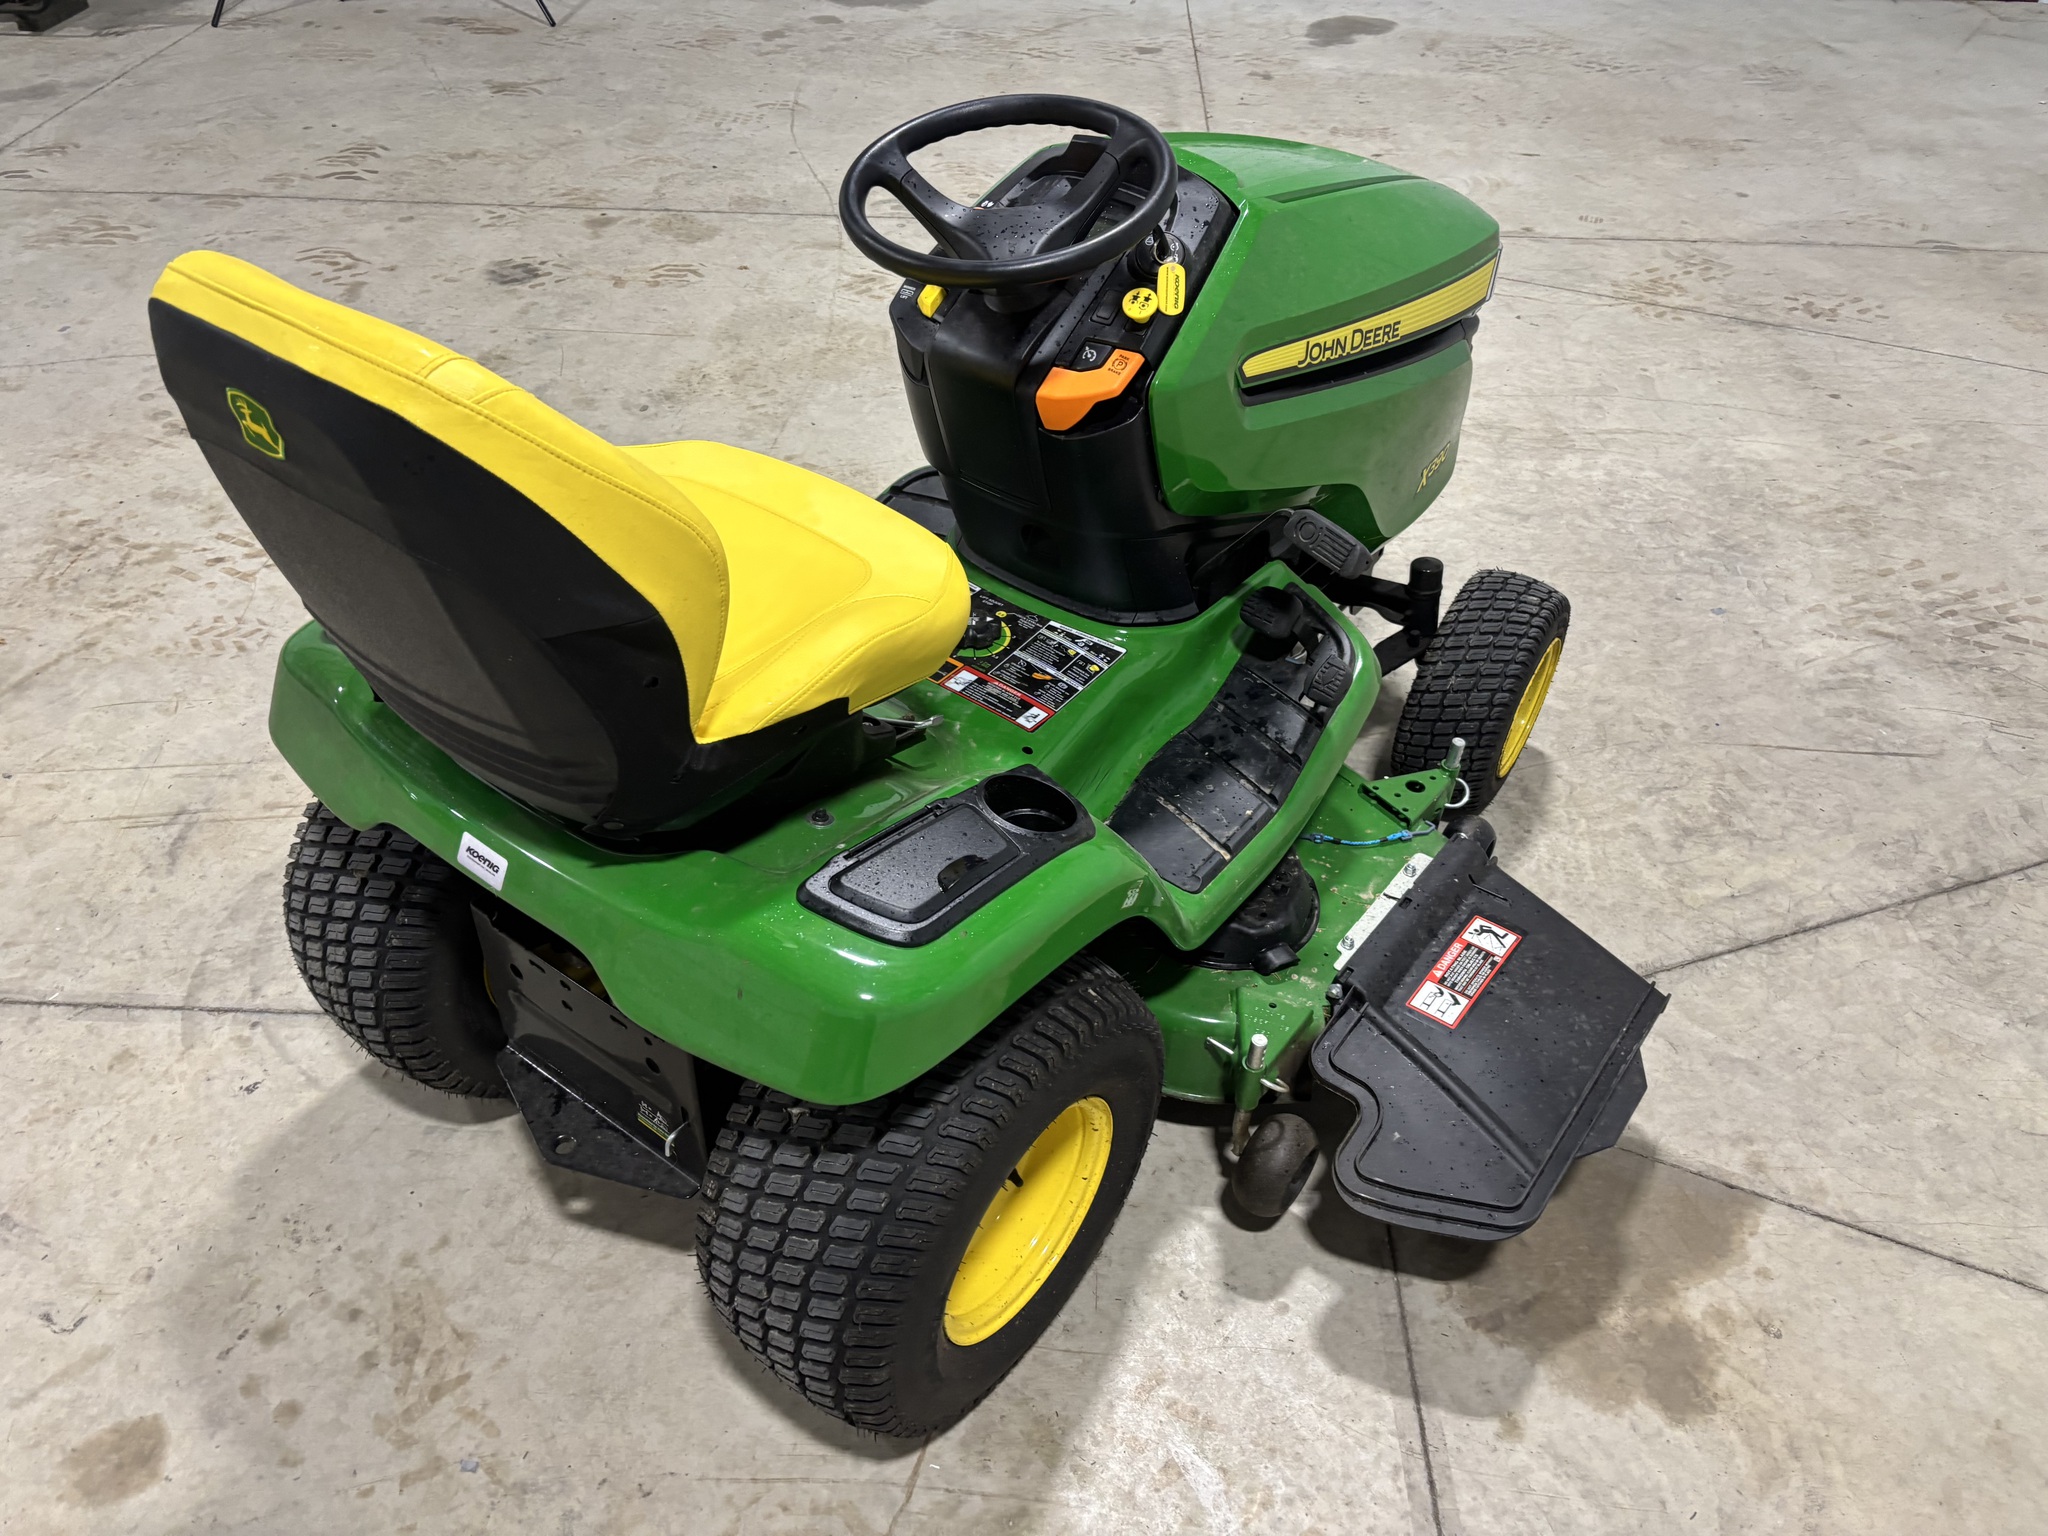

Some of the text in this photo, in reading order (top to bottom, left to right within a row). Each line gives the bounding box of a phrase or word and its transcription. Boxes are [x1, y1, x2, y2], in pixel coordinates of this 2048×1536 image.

[1298, 320, 1401, 365] JOHN DEERE
[1437, 942, 1464, 971] DANGER
